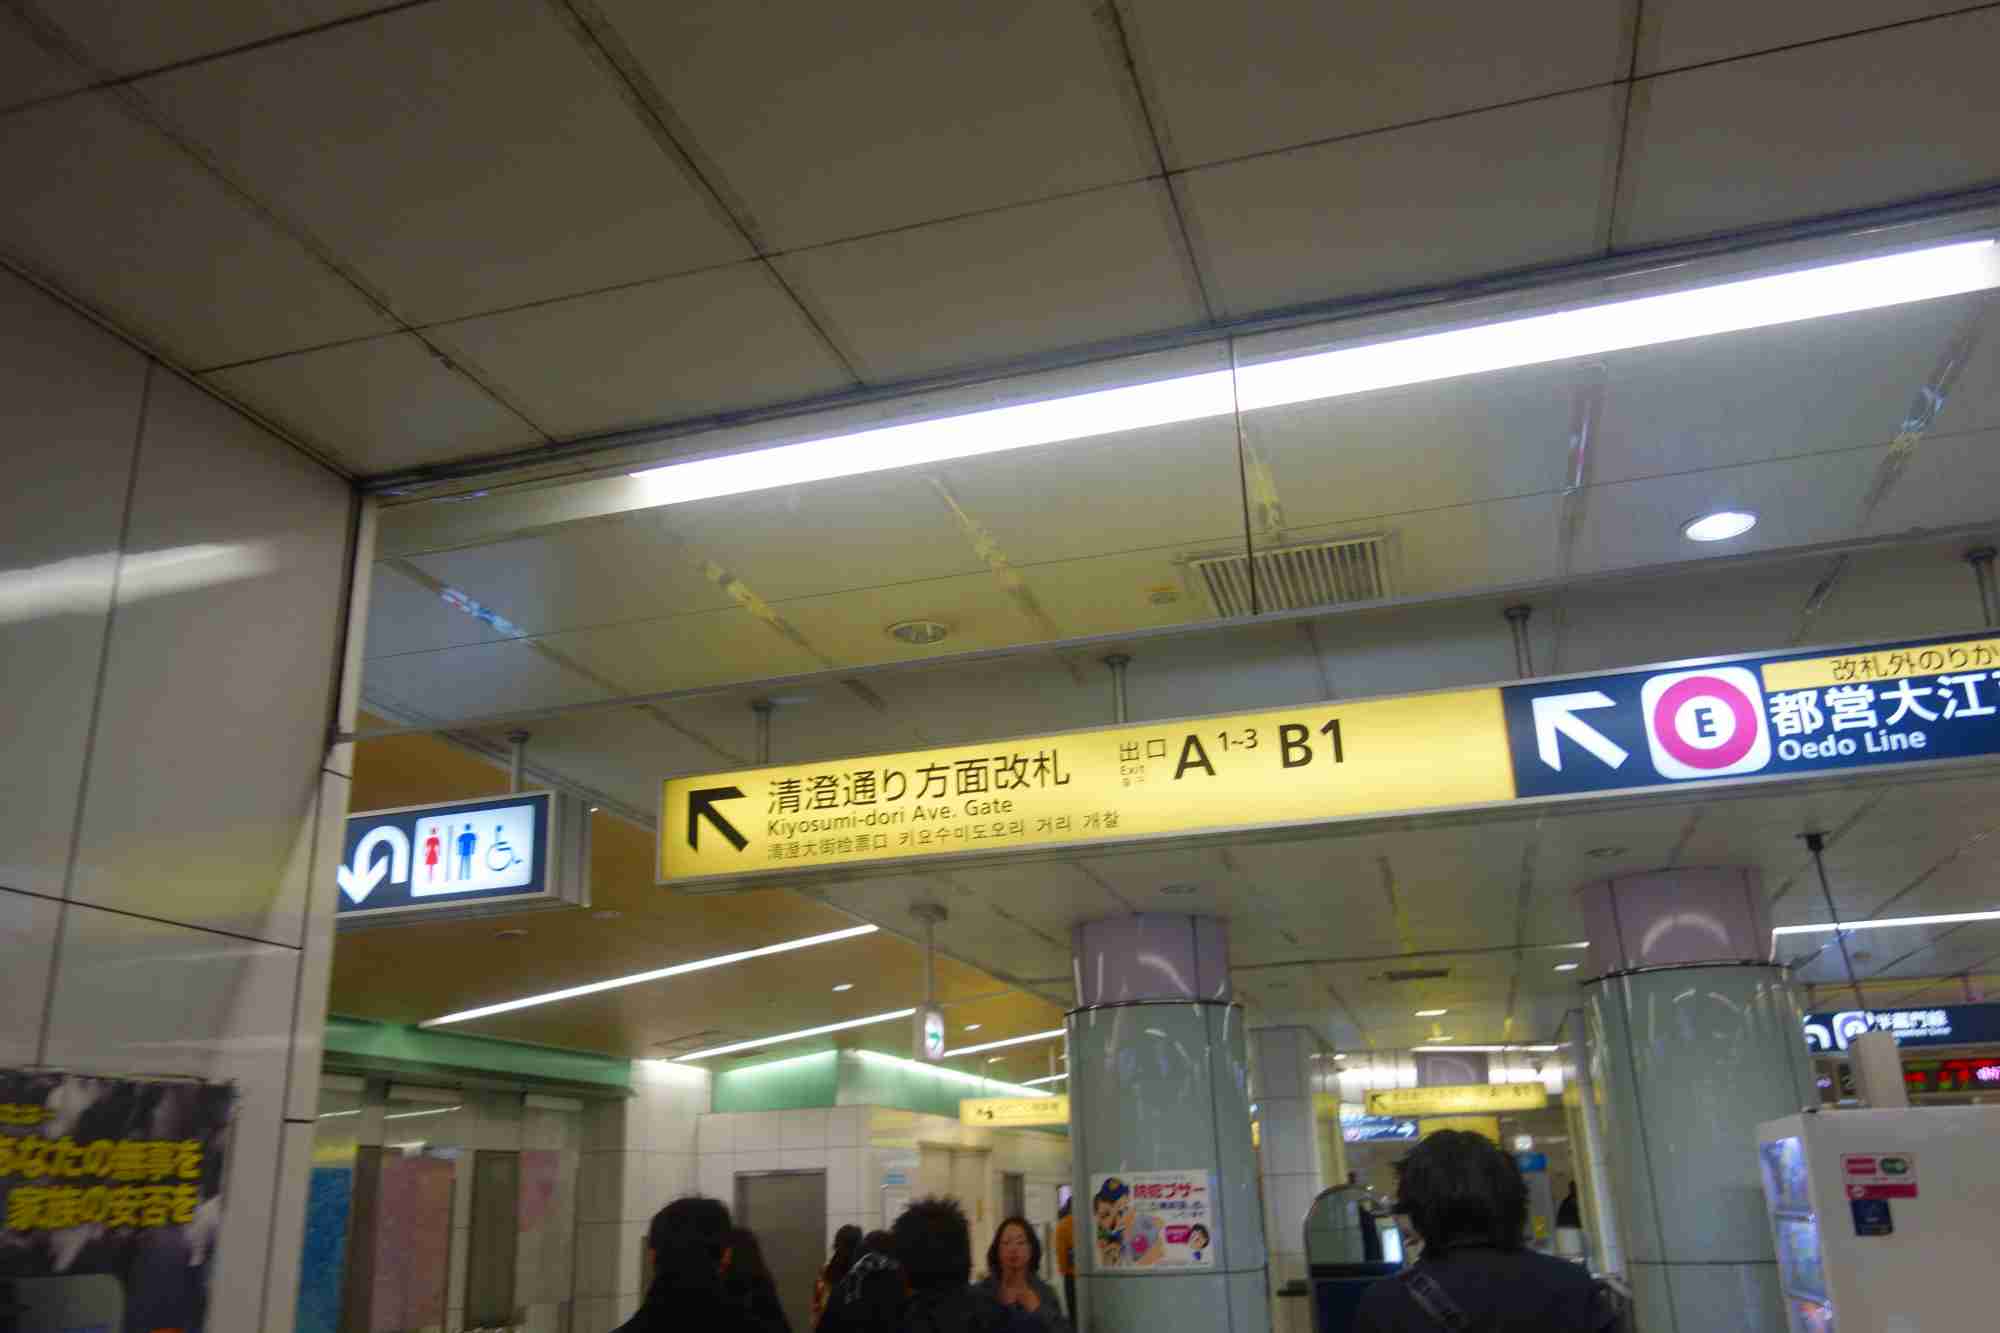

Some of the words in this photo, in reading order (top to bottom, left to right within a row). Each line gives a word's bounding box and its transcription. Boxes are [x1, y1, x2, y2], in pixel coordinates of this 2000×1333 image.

[1694, 707, 1717, 738] E
[1769, 670, 2000, 736] 都営大江
[1120, 737, 1167, 762] 出口
[1279, 718, 1344, 769] B1
[1778, 733, 1856, 761] Oedo
[1864, 729, 1927, 753] Line
[768, 748, 1071, 814] 清澄通り方面改札
[768, 807, 904, 840] Kiyosumi-dori
[912, 804, 957, 823] Ave.
[964, 798, 1014, 816] Gate
[1036, 815, 1073, 834] 거리
